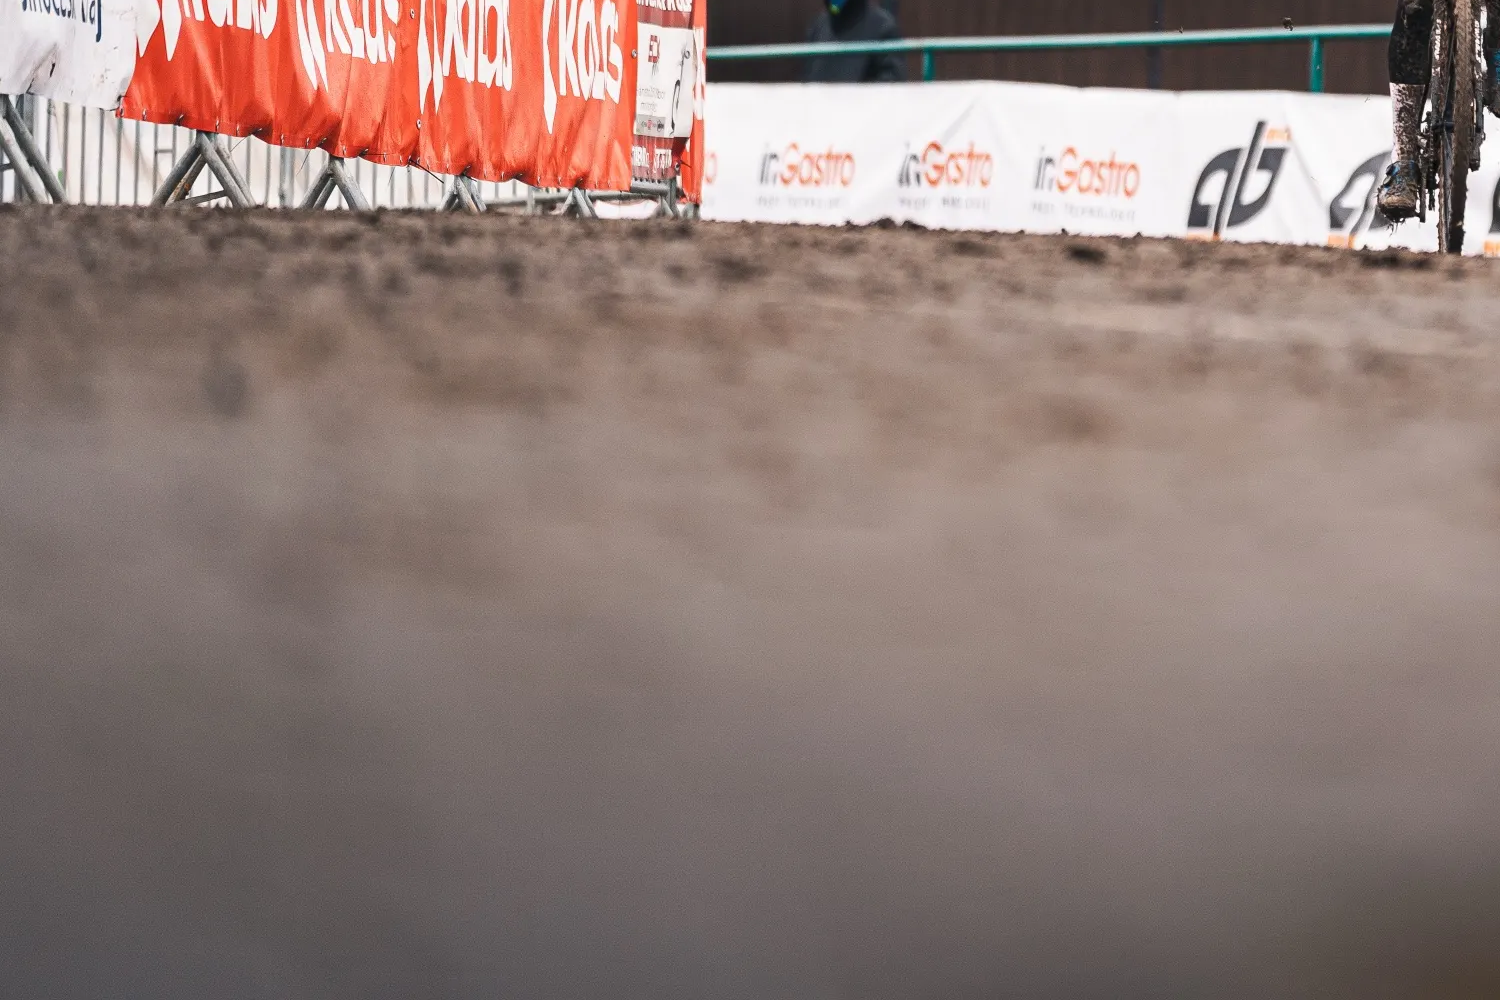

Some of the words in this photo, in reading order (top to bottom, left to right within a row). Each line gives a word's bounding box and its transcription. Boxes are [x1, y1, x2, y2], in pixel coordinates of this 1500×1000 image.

[760, 142, 855, 187] inGastro
[898, 141, 992, 187] inGastro
[1035, 146, 1140, 198] inGastro
